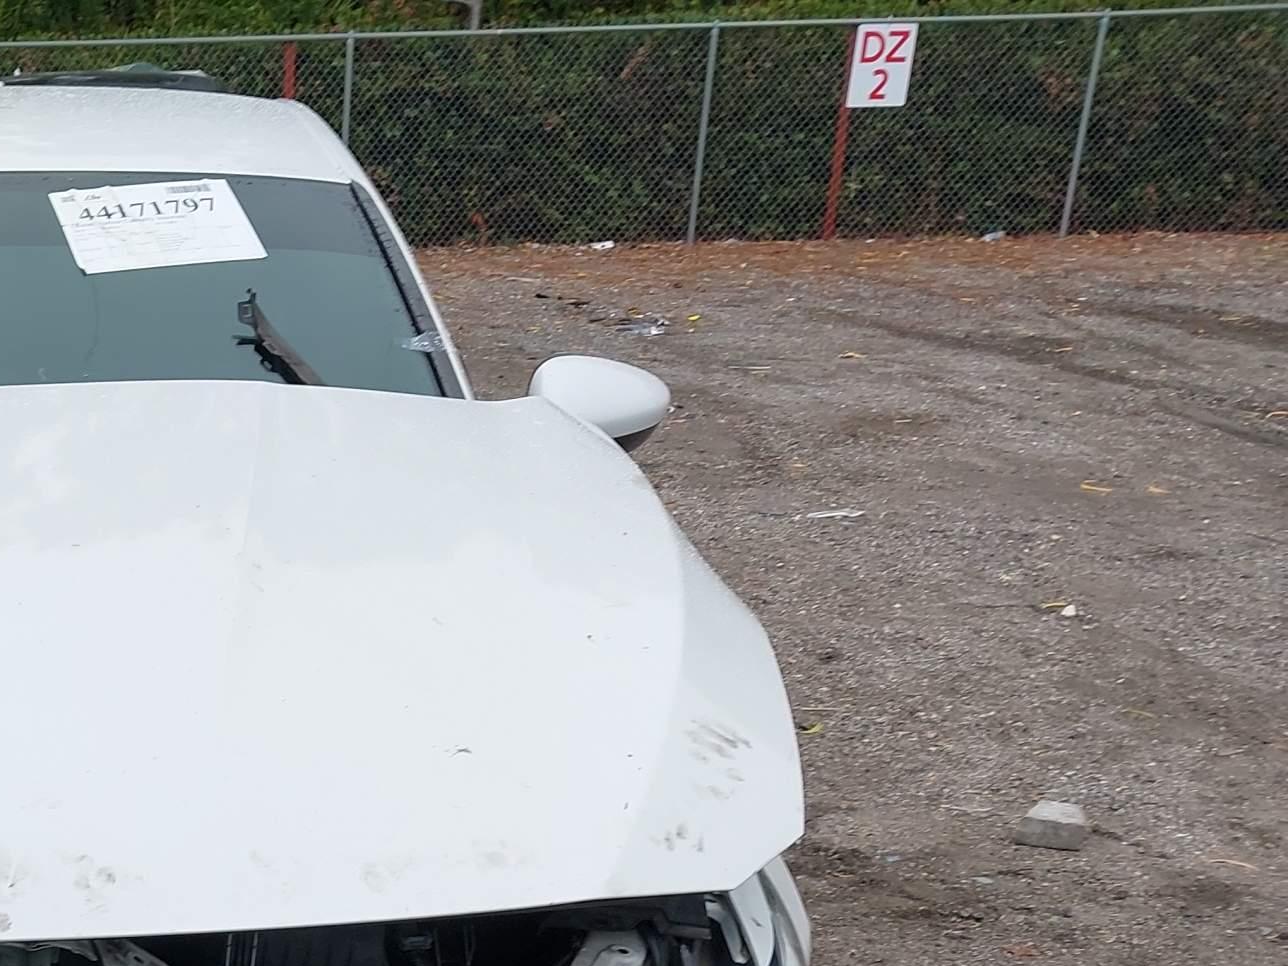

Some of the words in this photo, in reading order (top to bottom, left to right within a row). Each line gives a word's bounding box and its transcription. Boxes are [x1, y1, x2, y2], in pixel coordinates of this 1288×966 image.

[860, 31, 911, 63] DZ
[868, 68, 889, 100] 2
[79, 196, 214, 221] 44171797
